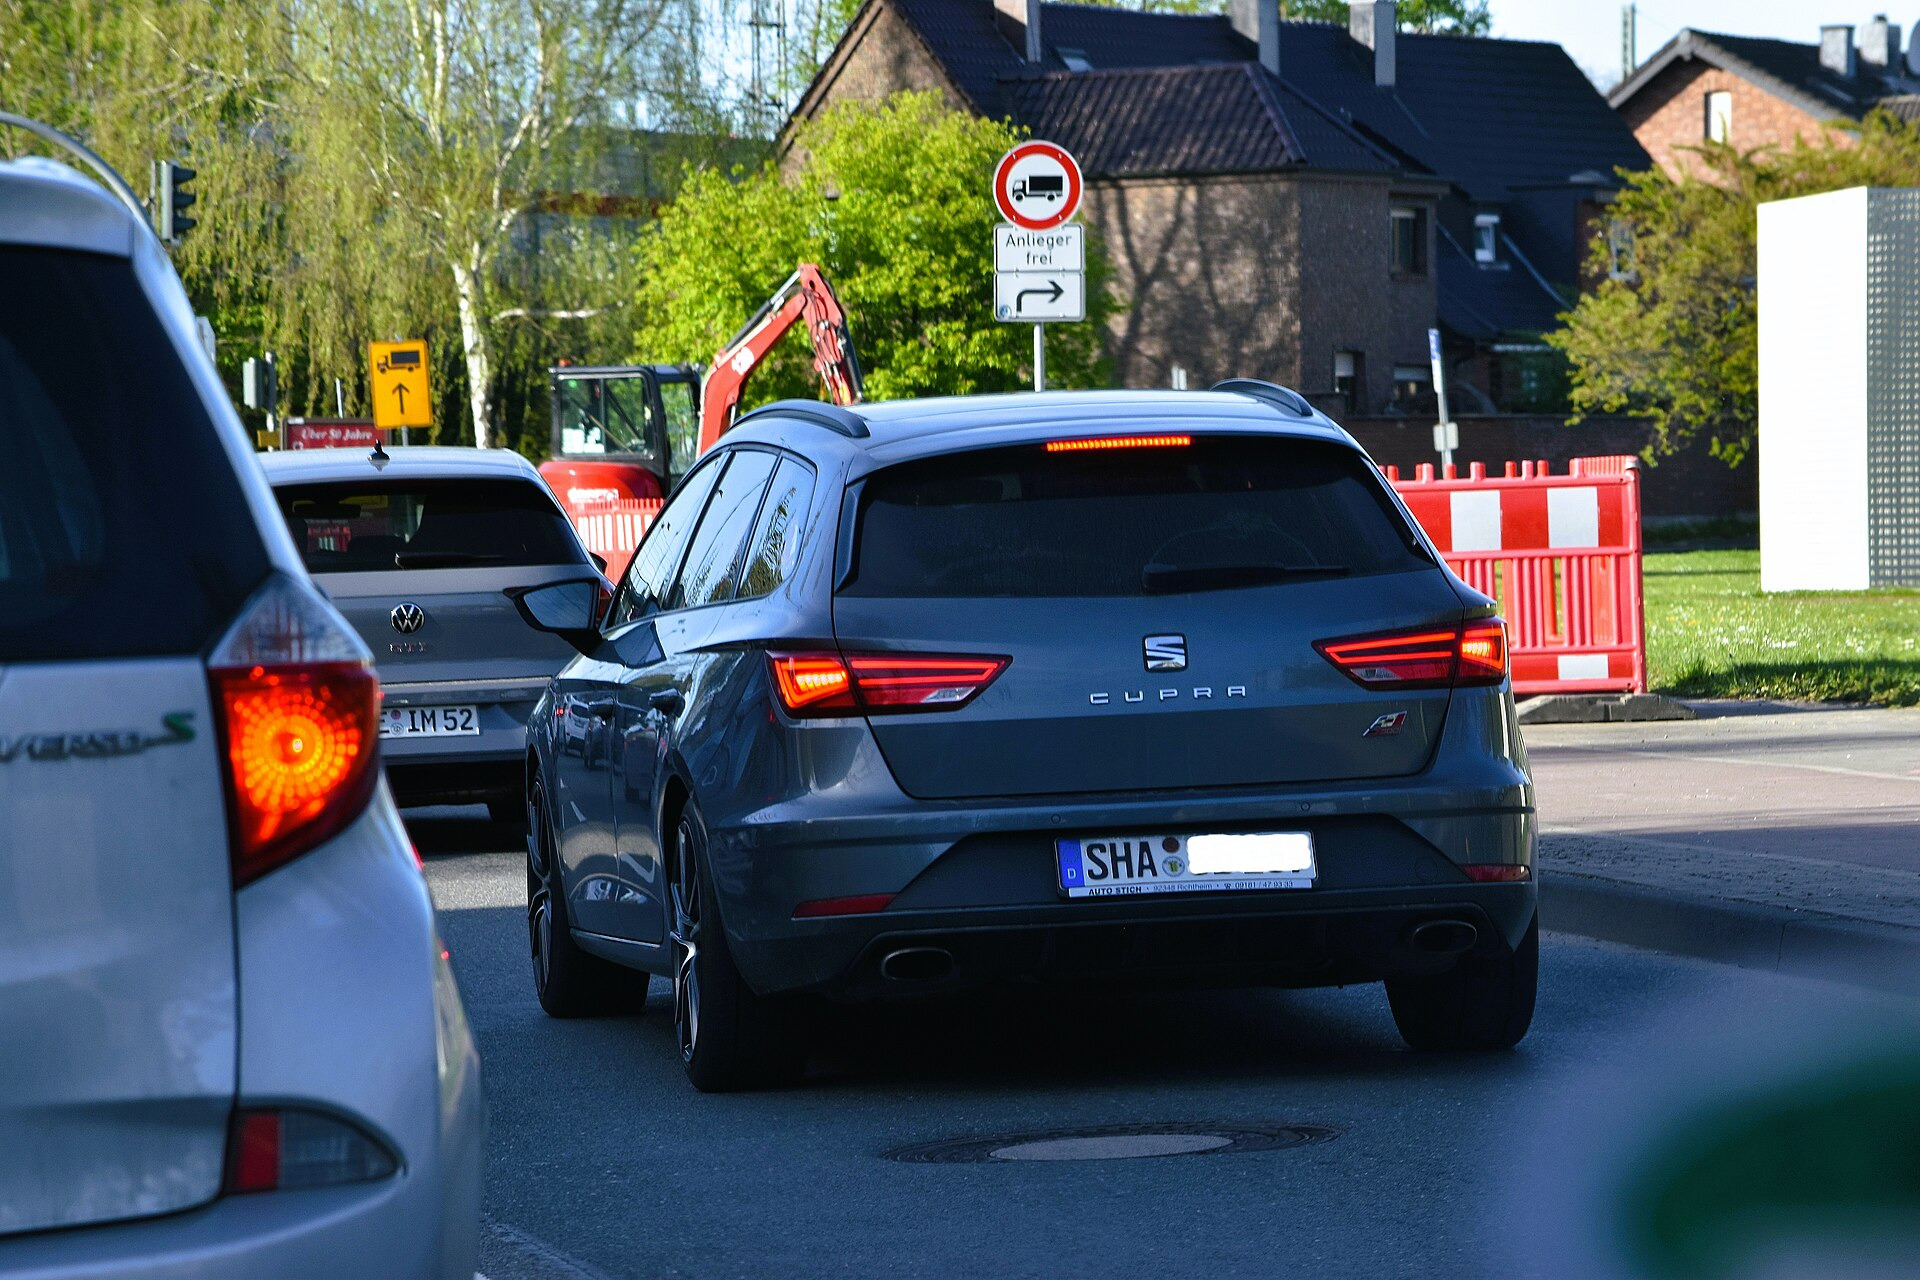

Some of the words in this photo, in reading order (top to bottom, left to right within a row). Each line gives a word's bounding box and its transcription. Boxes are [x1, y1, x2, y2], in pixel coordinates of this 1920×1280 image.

[1005, 233, 1072, 250] Anlieger
[1026, 251, 1052, 265] frei
[1089, 685, 1246, 704] CUPRA
[408, 709, 437, 732] IM
[443, 708, 474, 731] 52
[1086, 841, 1158, 880] SHA
[1067, 868, 1076, 879] D
[1088, 887, 1113, 896] AUTO
[1115, 885, 1142, 894] STICH
